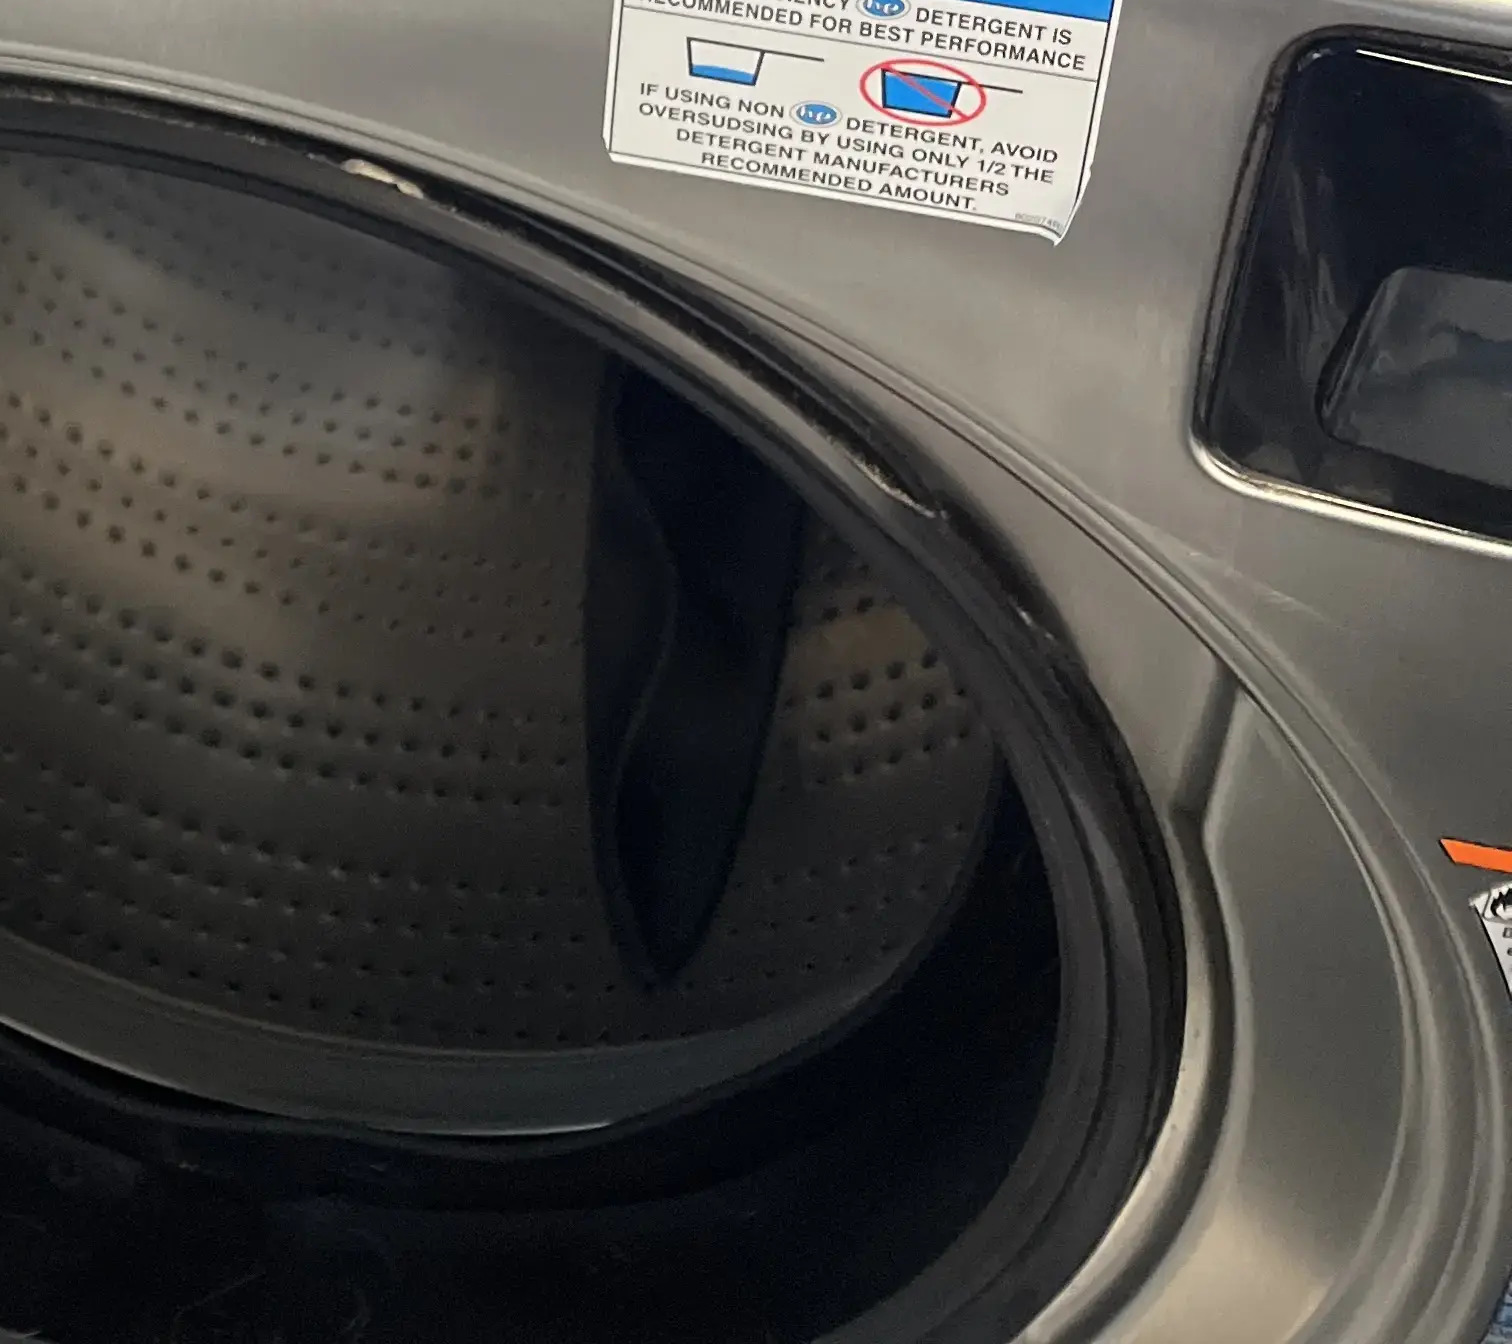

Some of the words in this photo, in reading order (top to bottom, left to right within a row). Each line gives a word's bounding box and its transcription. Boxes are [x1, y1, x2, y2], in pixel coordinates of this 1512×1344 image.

[810, 13, 852, 33] FOR
[859, 21, 915, 43] BEST
[921, 31, 1086, 71] PERFORMANCE
[916, 7, 1047, 41] DETERGENT
[1053, 28, 1072, 45] IS
[639, 103, 793, 140] OVERSUDSING
[801, 129, 830, 145] BY
[837, 136, 904, 159] USING
[912, 149, 970, 168] ONLY
[977, 160, 1006, 176] 1/2
[1011, 165, 1054, 184] THE
[640, 84, 657, 96] IF
[665, 86, 731, 109] USING
[738, 100, 784, 118] NON
[846, 117, 985, 153] DETERGENT,
[991, 142, 1058, 163] AVOID
[677, 128, 806, 161] DETERGENT
[812, 152, 1009, 196] MANUFACTURERS
[701, 152, 873, 192] RECOMMENDED
[879, 183, 977, 211] AMOUNT.
